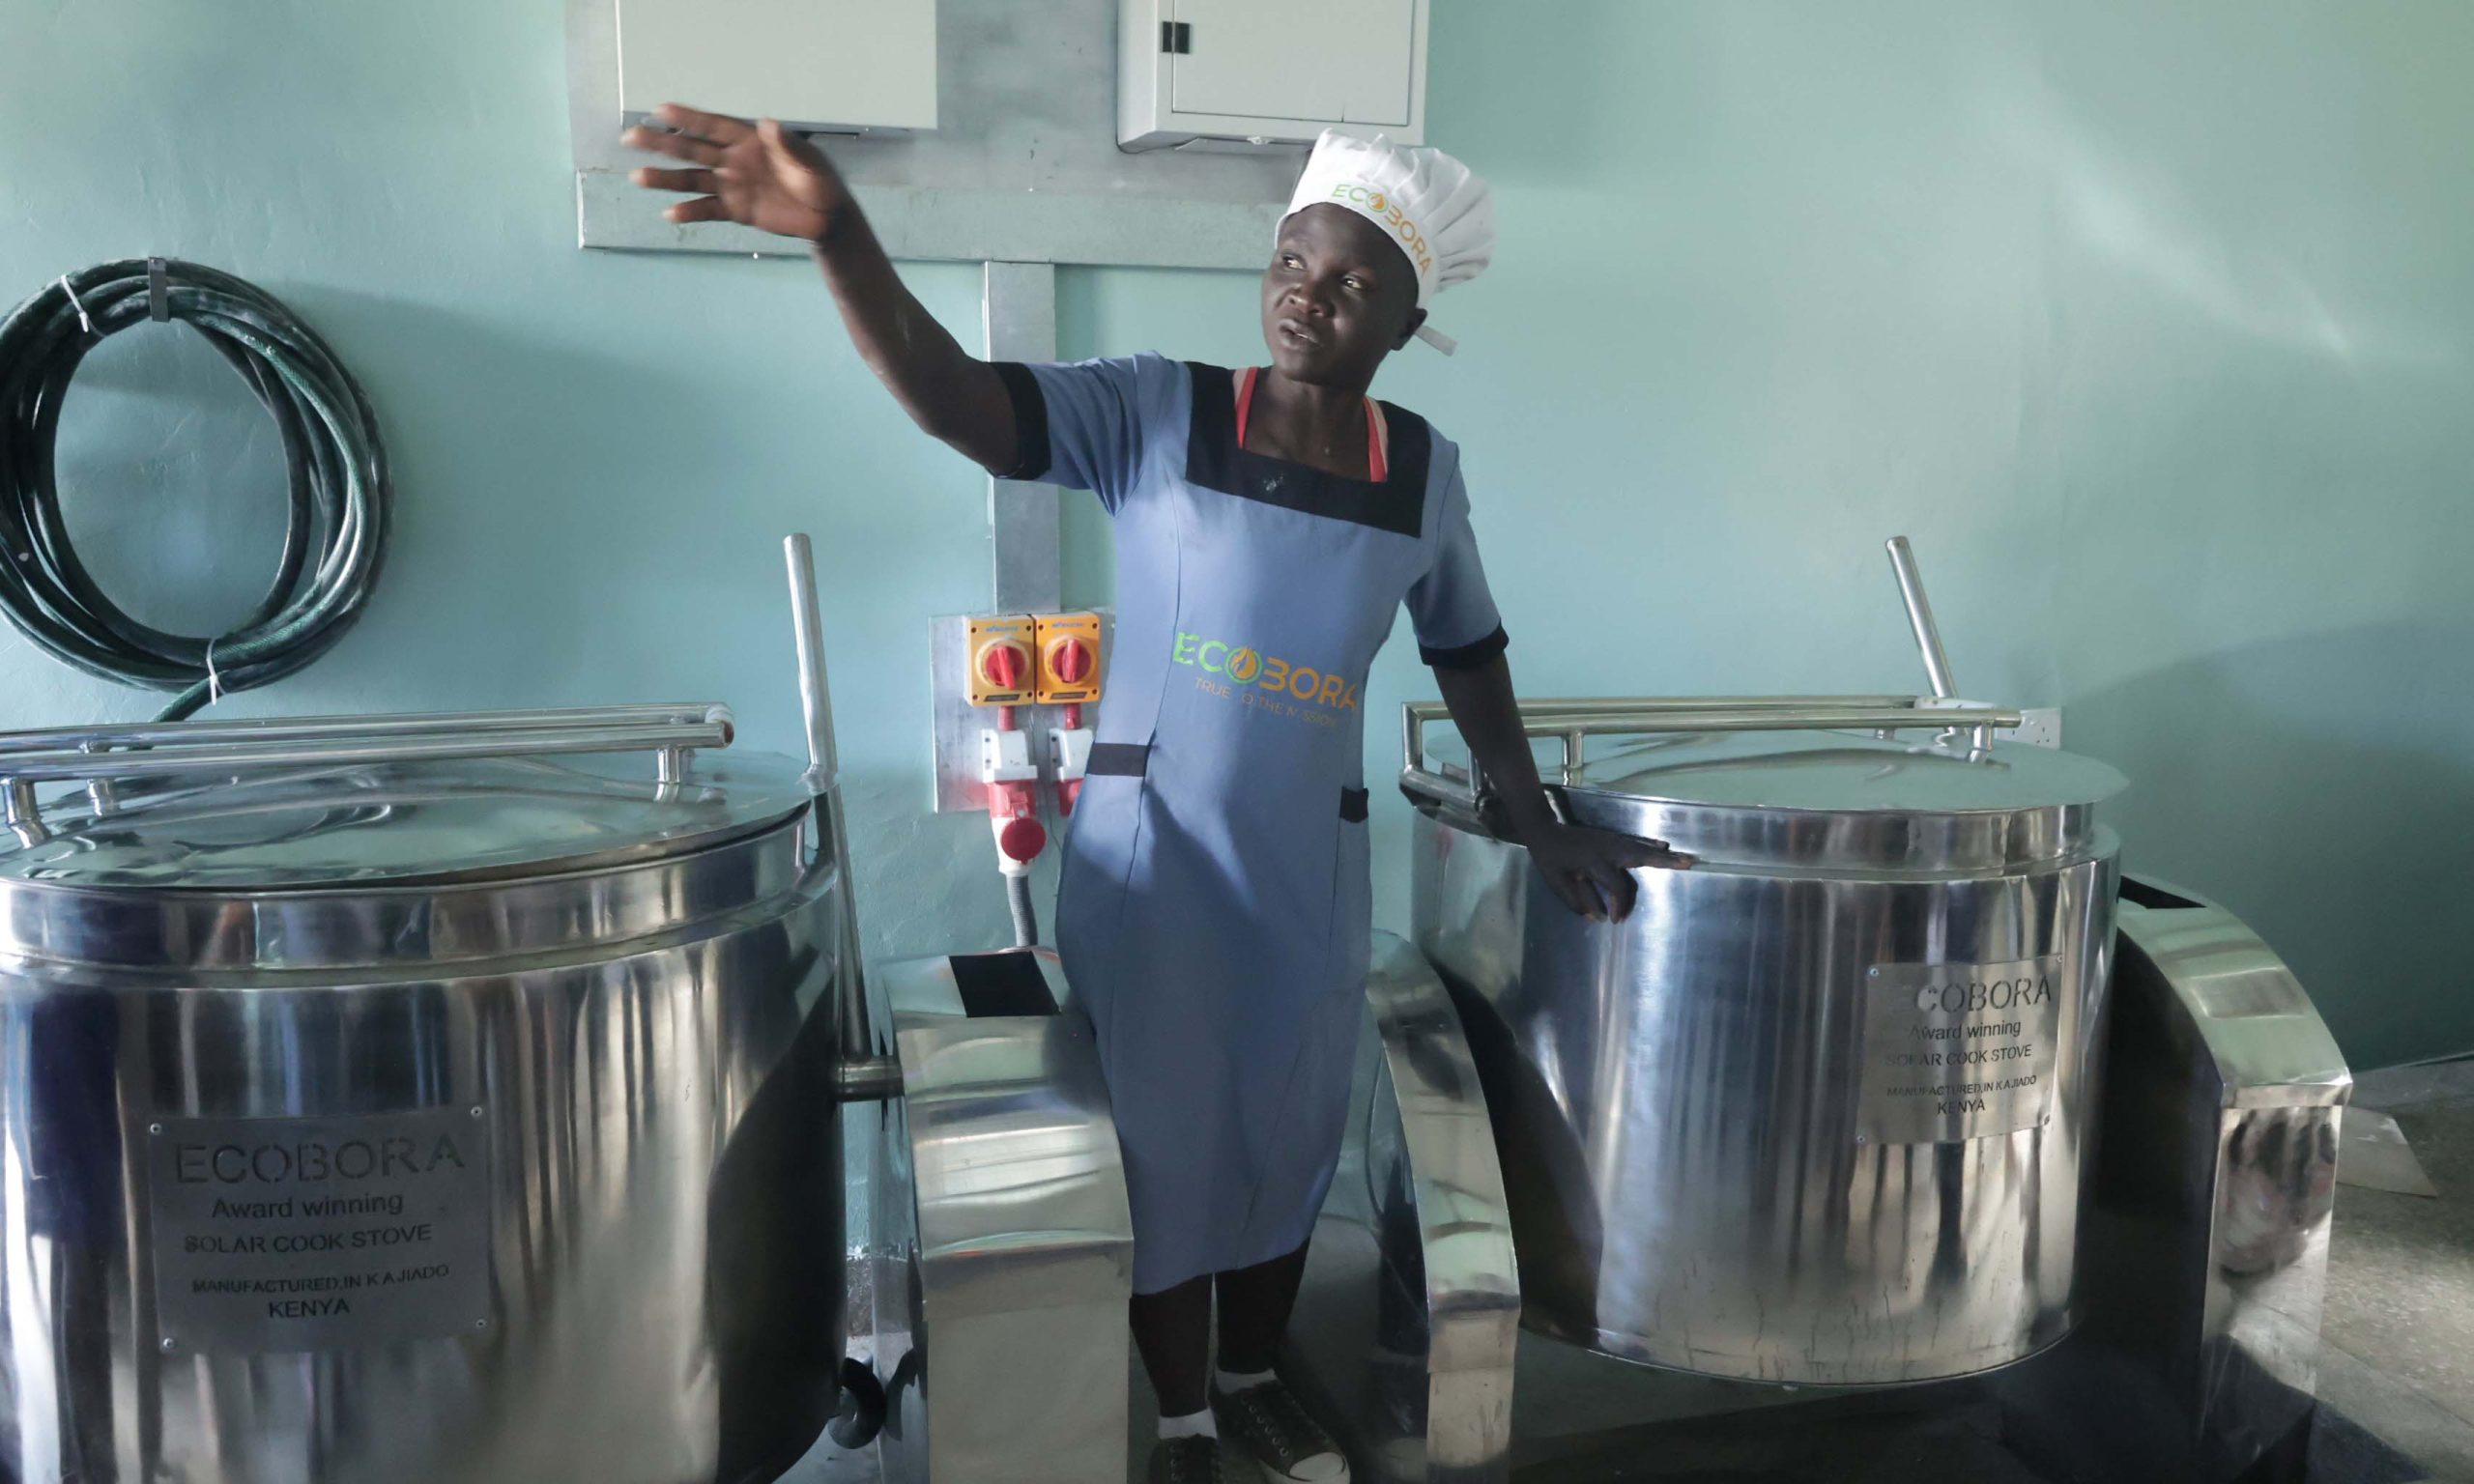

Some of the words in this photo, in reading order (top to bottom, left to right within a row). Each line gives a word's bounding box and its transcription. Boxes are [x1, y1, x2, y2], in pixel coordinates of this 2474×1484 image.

[1194, 676, 1231, 699] TRUE
[1910, 1023, 1962, 1041] Award
[1967, 1019, 2022, 1038] winning
[1945, 1050, 1988, 1065] COOK
[1991, 1043, 2032, 1062] STOVE
[1937, 1099, 1987, 1115] KENYA
[175, 1132, 466, 1185] ECOBORA
[212, 1197, 293, 1219] Award
[303, 1191, 404, 1215] winning
[184, 1234, 267, 1254] SOLAR
[273, 1232, 345, 1253] COOK
[352, 1223, 433, 1248] STOVE
[268, 1298, 351, 1319] KENYA
